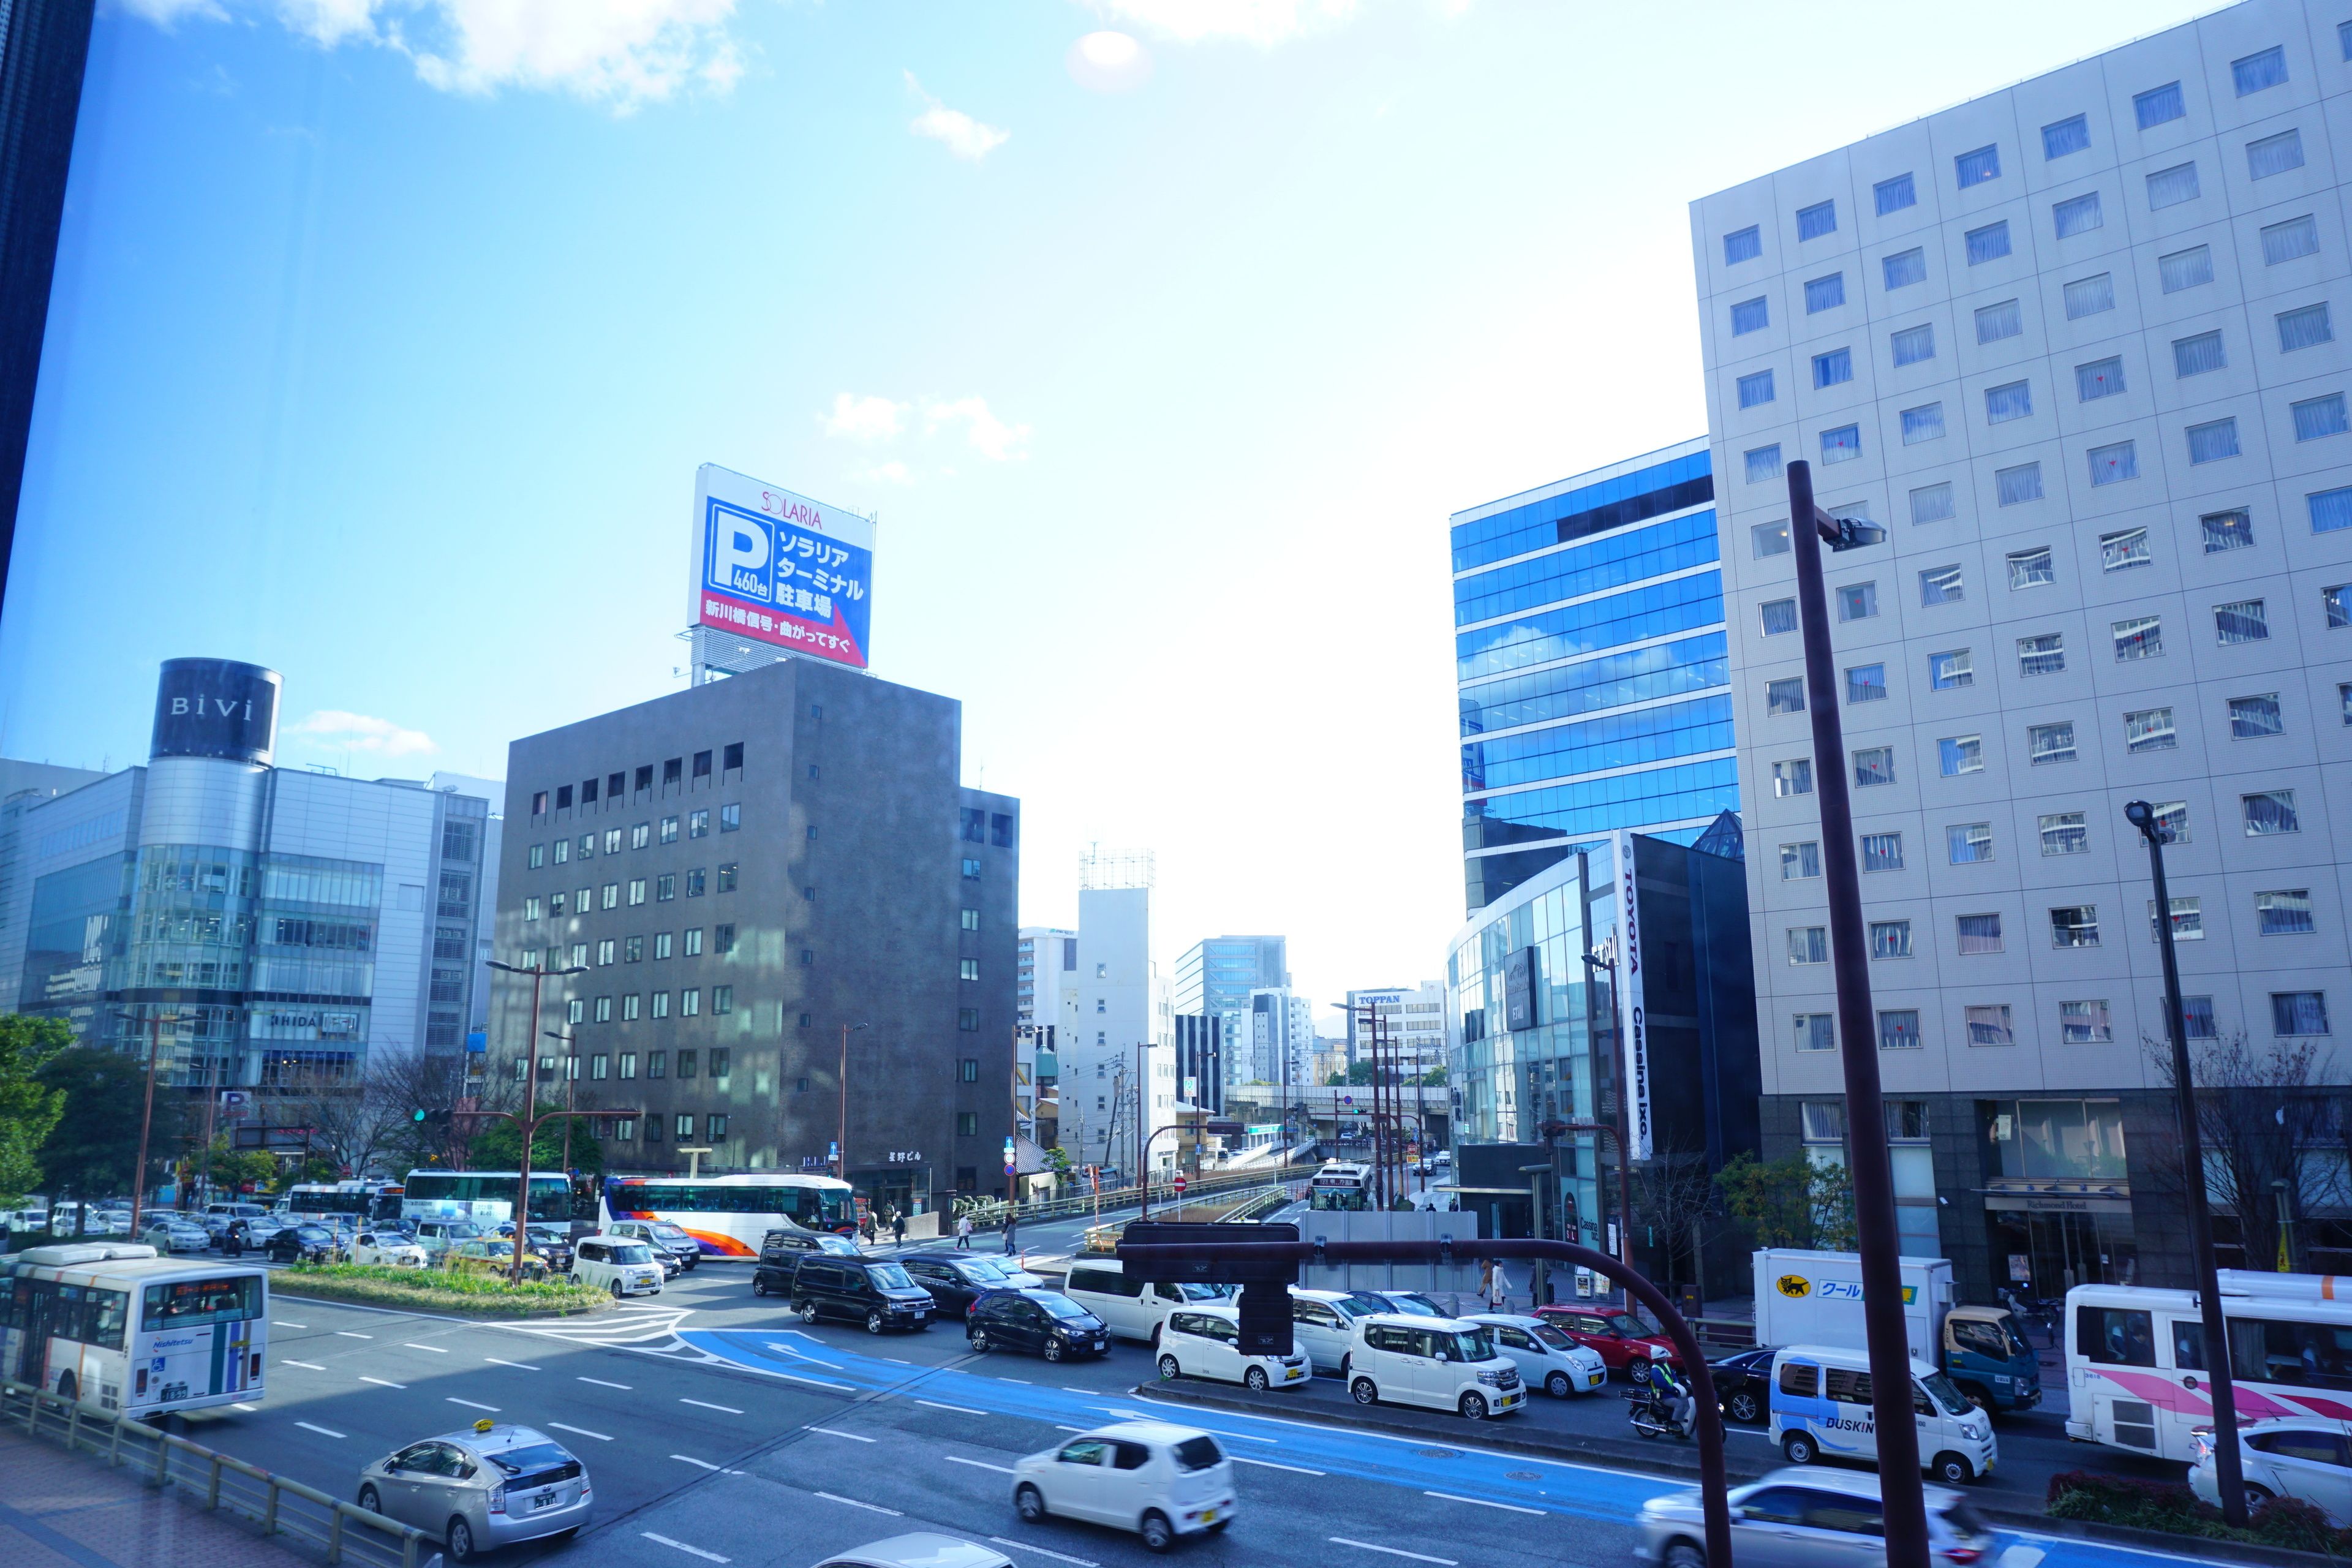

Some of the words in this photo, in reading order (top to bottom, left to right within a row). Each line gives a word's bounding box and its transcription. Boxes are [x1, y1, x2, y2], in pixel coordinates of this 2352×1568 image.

[761, 491, 822, 530] SOLARIA
[714, 510, 769, 587] P
[779, 531, 849, 567] ソラリア
[733, 570, 768, 597] 460台
[777, 557, 864, 601] ターミナル
[775, 582, 832, 619] 駐車場
[1624, 868, 1638, 976] TOYOTA
[1359, 995, 1401, 1005] TOPPAN
[281, 1015, 317, 1027] HIDA
[1633, 1006, 1646, 1098] Cassina
[889, 1151, 921, 1163] 星野ビル
[2027, 1200, 2065, 1209] Richmond
[2067, 1200, 2087, 1210] Hotel
[1580, 1216, 1598, 1232] Cassina
[153, 1338, 194, 1348] Nishitetsu
